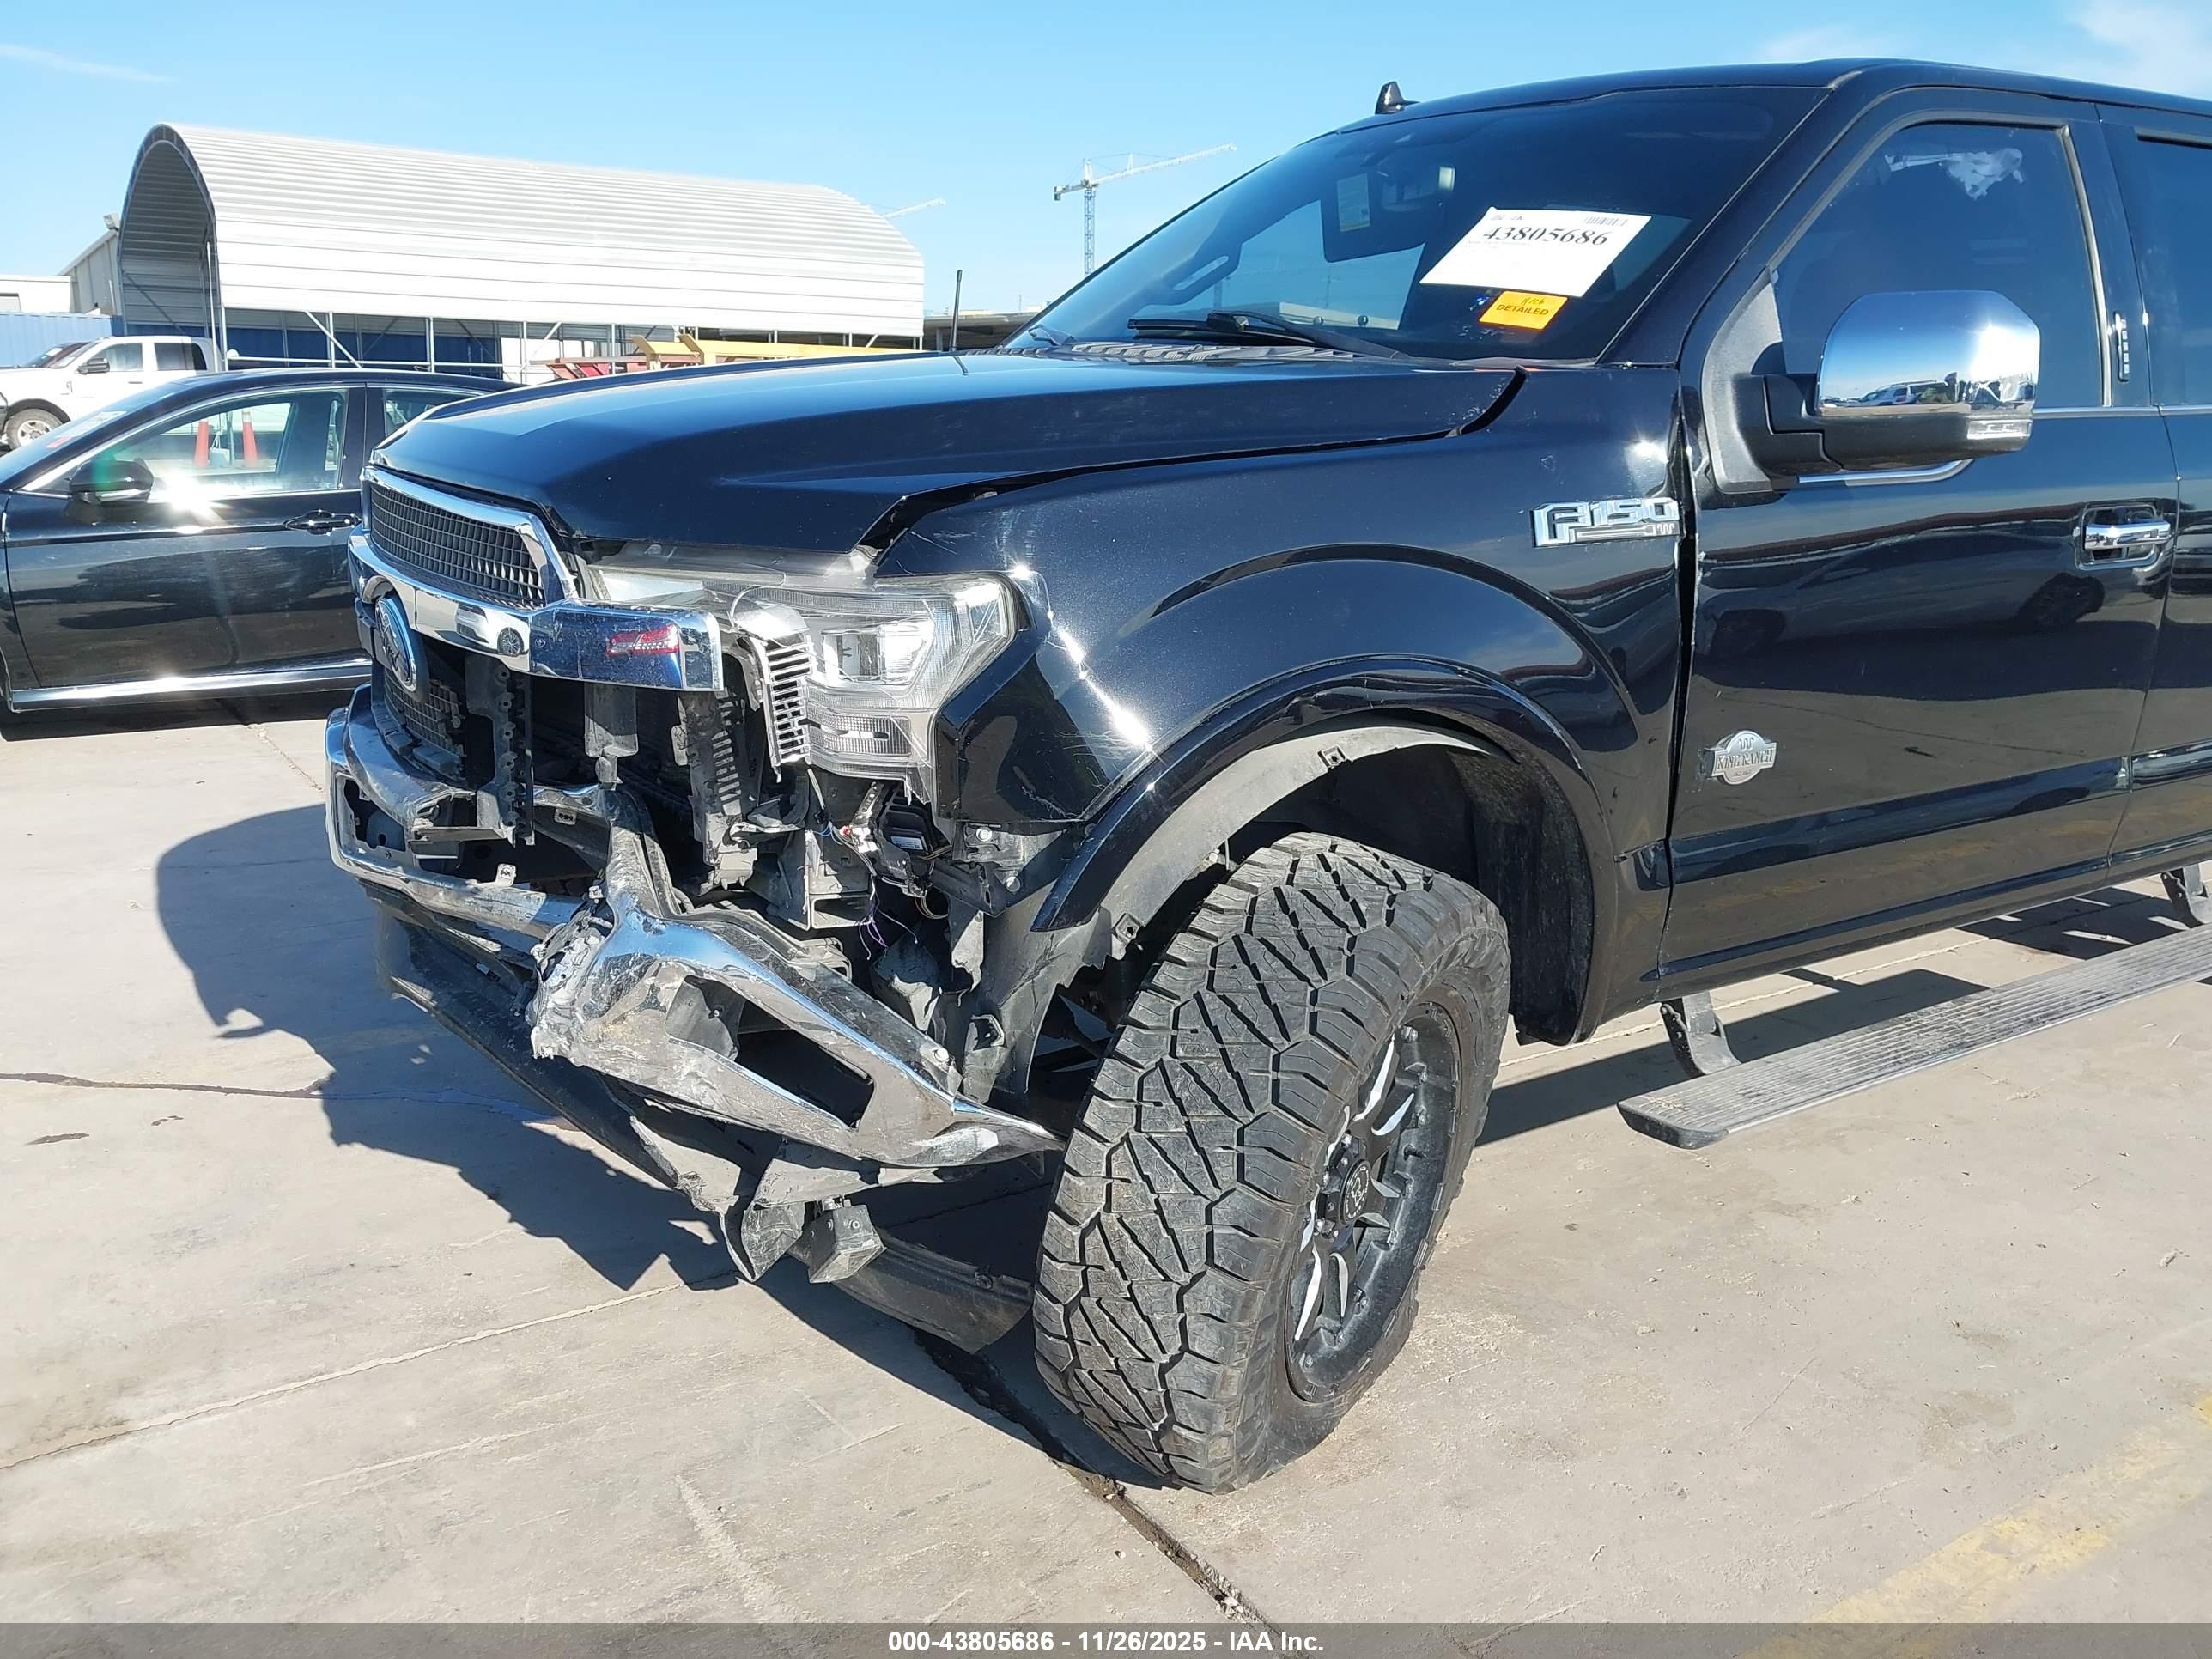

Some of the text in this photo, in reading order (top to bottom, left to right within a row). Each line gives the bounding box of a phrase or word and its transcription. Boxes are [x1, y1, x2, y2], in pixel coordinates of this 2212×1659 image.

[1484, 227, 1613, 246] 43805686
[1497, 304, 1549, 315] DETAILED
[1717, 748, 1773, 770] KING RANCH
